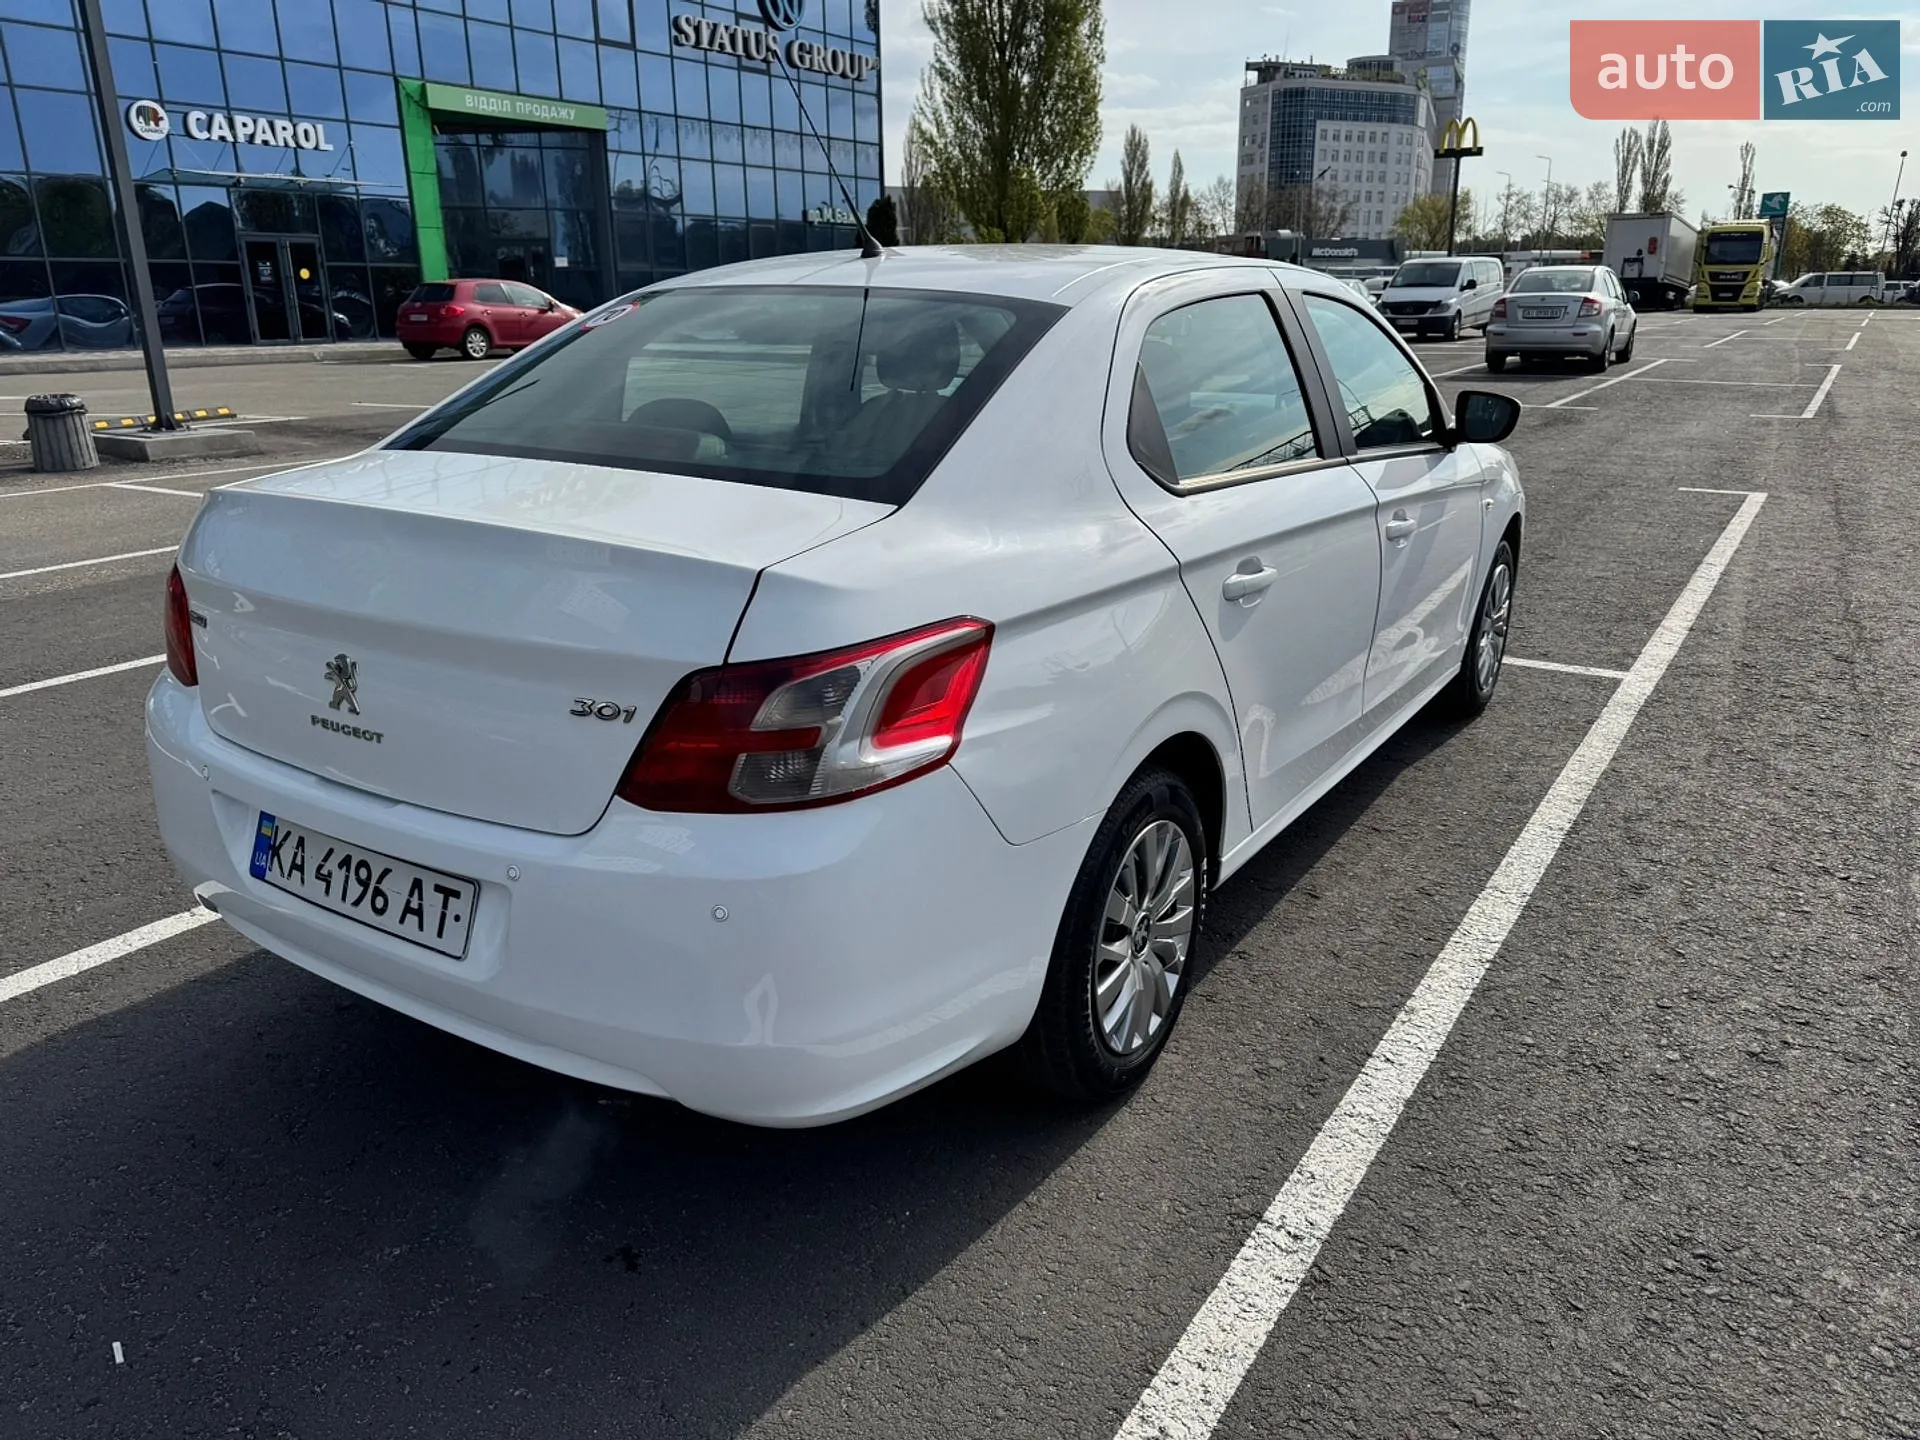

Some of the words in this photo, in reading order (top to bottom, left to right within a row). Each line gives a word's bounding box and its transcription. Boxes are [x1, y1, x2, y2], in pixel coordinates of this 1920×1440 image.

[673, 14, 781, 62] STATUS
[786, 39, 871, 81] GROUP
[465, 94, 511, 112] ВІДДІЛ
[516, 102, 576, 121] ПРОДАЖУ
[186, 110, 334, 151] CAPAROL
[569, 697, 638, 724] 301
[310, 714, 384, 744] PEUGEOT
[254, 851, 267, 869] UA
[267, 825, 305, 886] KA
[315, 847, 393, 917] 4196
[398, 877, 462, 939] AT
